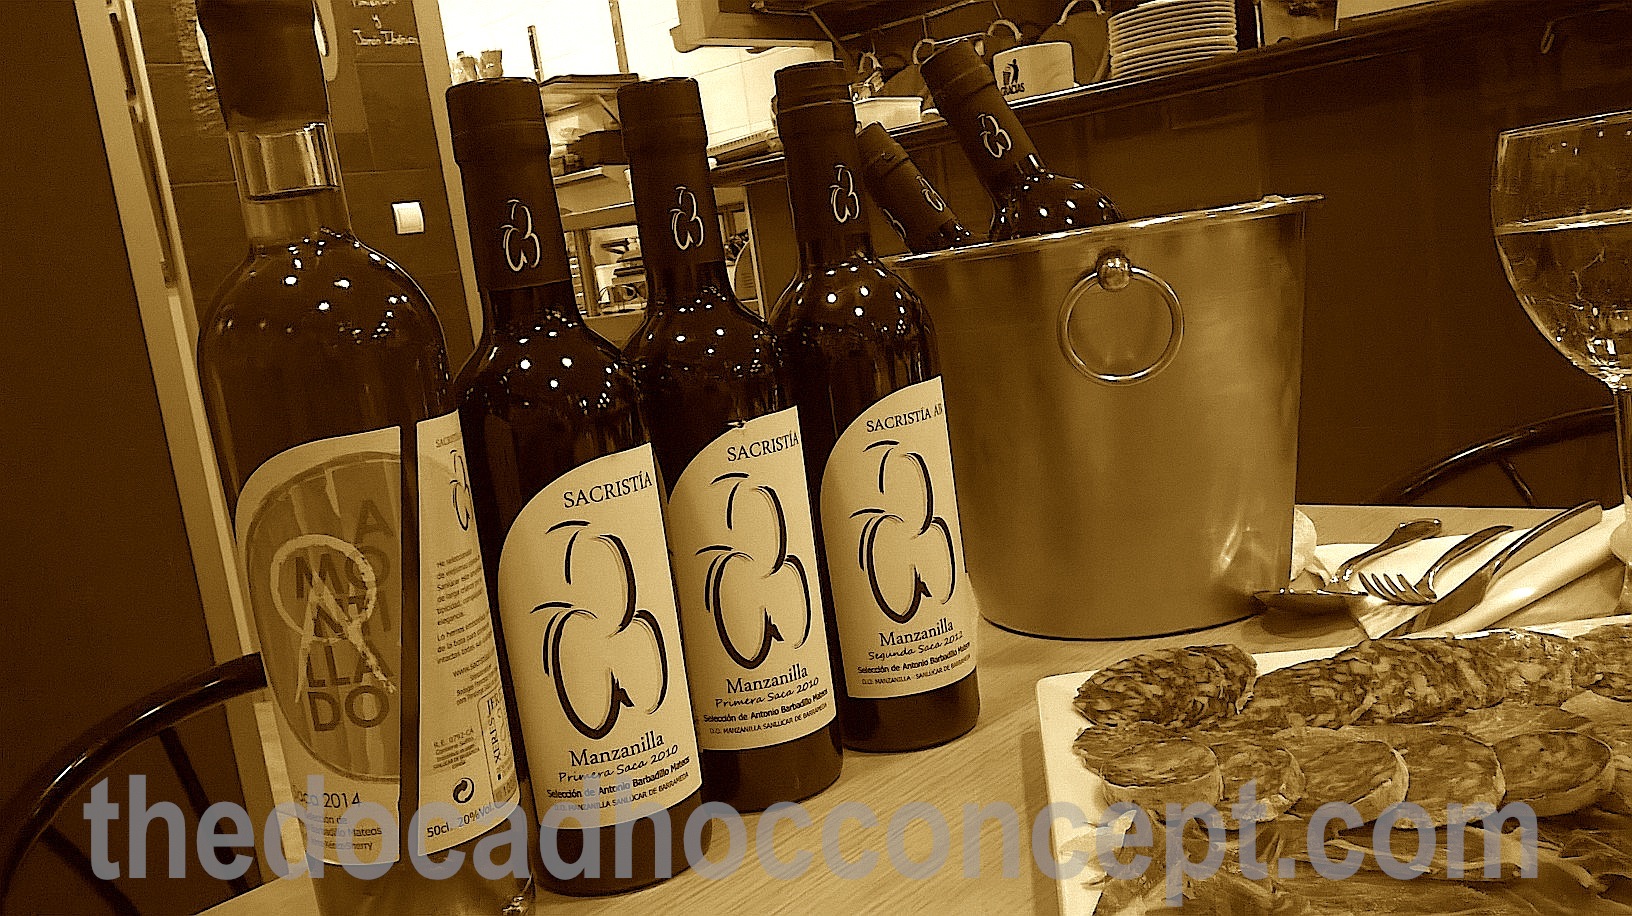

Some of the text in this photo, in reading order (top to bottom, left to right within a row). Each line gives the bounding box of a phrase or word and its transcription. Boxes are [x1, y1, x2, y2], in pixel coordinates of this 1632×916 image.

[866, 408, 931, 432] SACRISTÍA
[727, 430, 799, 461] SACRISTÍA
[563, 470, 653, 508] SACRISTÍA
[878, 617, 954, 646] Manzanilla
[857, 664, 889, 674] Selección
[890, 663, 900, 672] de
[902, 659, 928, 671] Antonio
[929, 649, 957, 665] Barbadillo
[868, 646, 916, 661] Segunda
[917, 642, 943, 654] Saca
[715, 677, 819, 709] Primera Saca 2010
[726, 663, 808, 694] Manzanilla
[703, 714, 736, 723] Selección
[738, 713, 748, 721] de
[751, 707, 780, 719] Antonio
[781, 698, 812, 714] Barbadillo
[558, 744, 678, 783] Primera Saca 2010
[568, 730, 665, 767] Manzanilla
[546, 789, 582, 799] Selección
[583, 787, 595, 797] de
[598, 780, 631, 796] Antonio
[632, 767, 670, 788] Barbadillo
[322, 792, 362, 809] 2014
